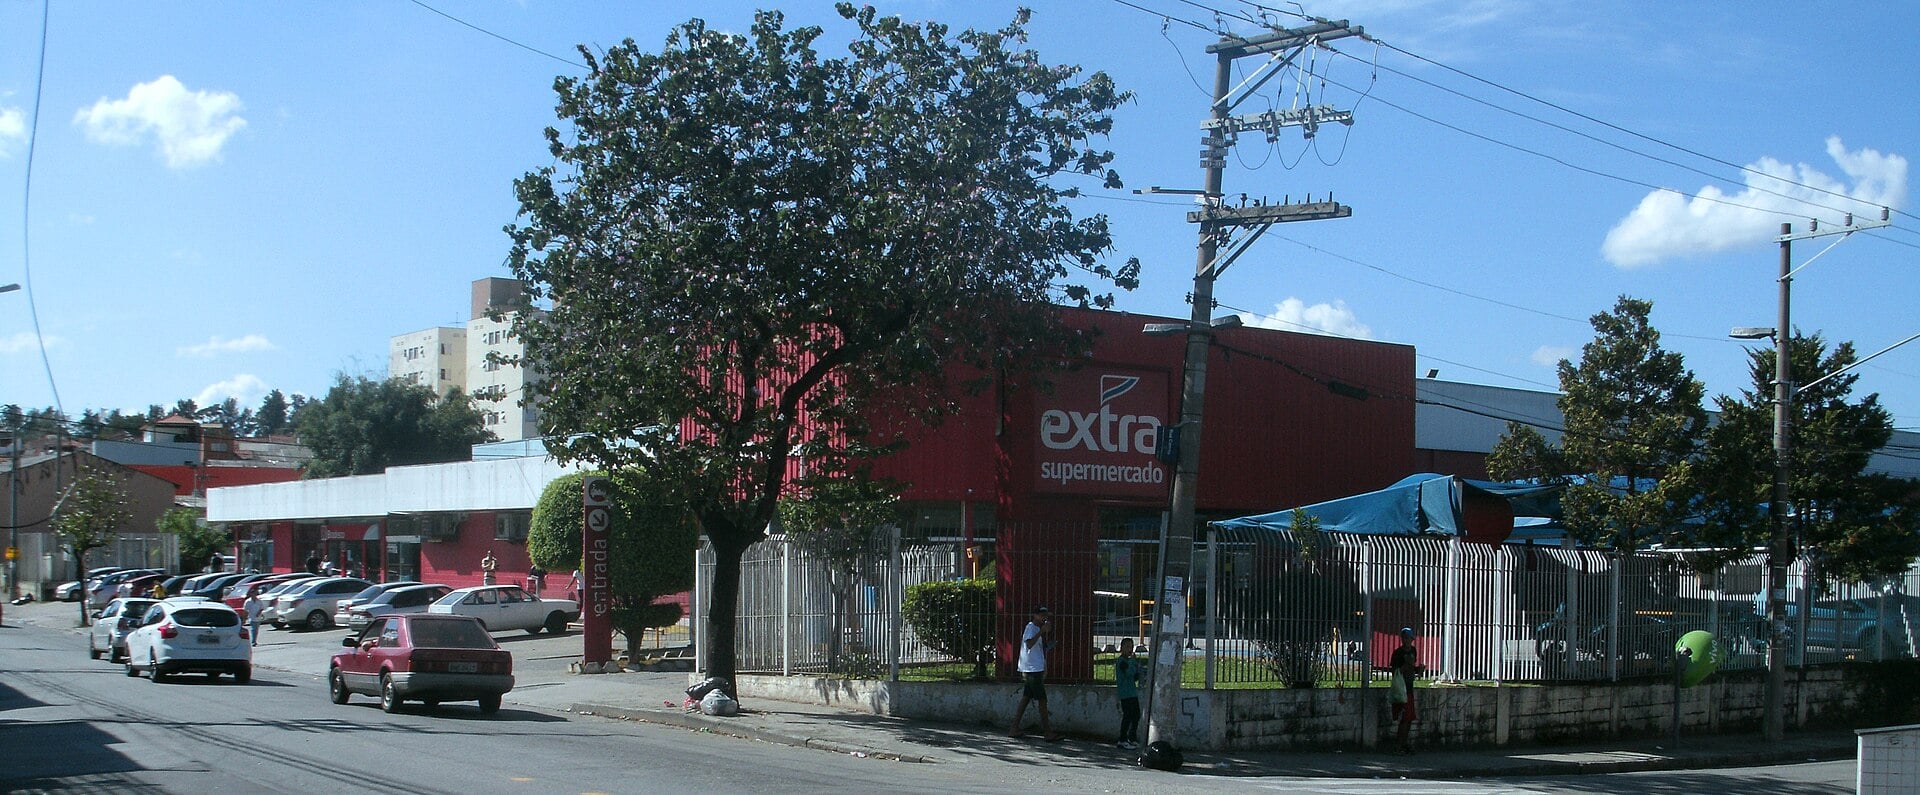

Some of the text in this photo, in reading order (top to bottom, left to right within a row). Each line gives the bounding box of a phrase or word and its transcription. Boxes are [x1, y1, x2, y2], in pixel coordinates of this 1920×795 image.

[1041, 404, 1161, 454] extra
[1041, 461, 1163, 485] supermercado
[589, 538, 607, 614] entrada
[1709, 640, 1718, 663] vivo
